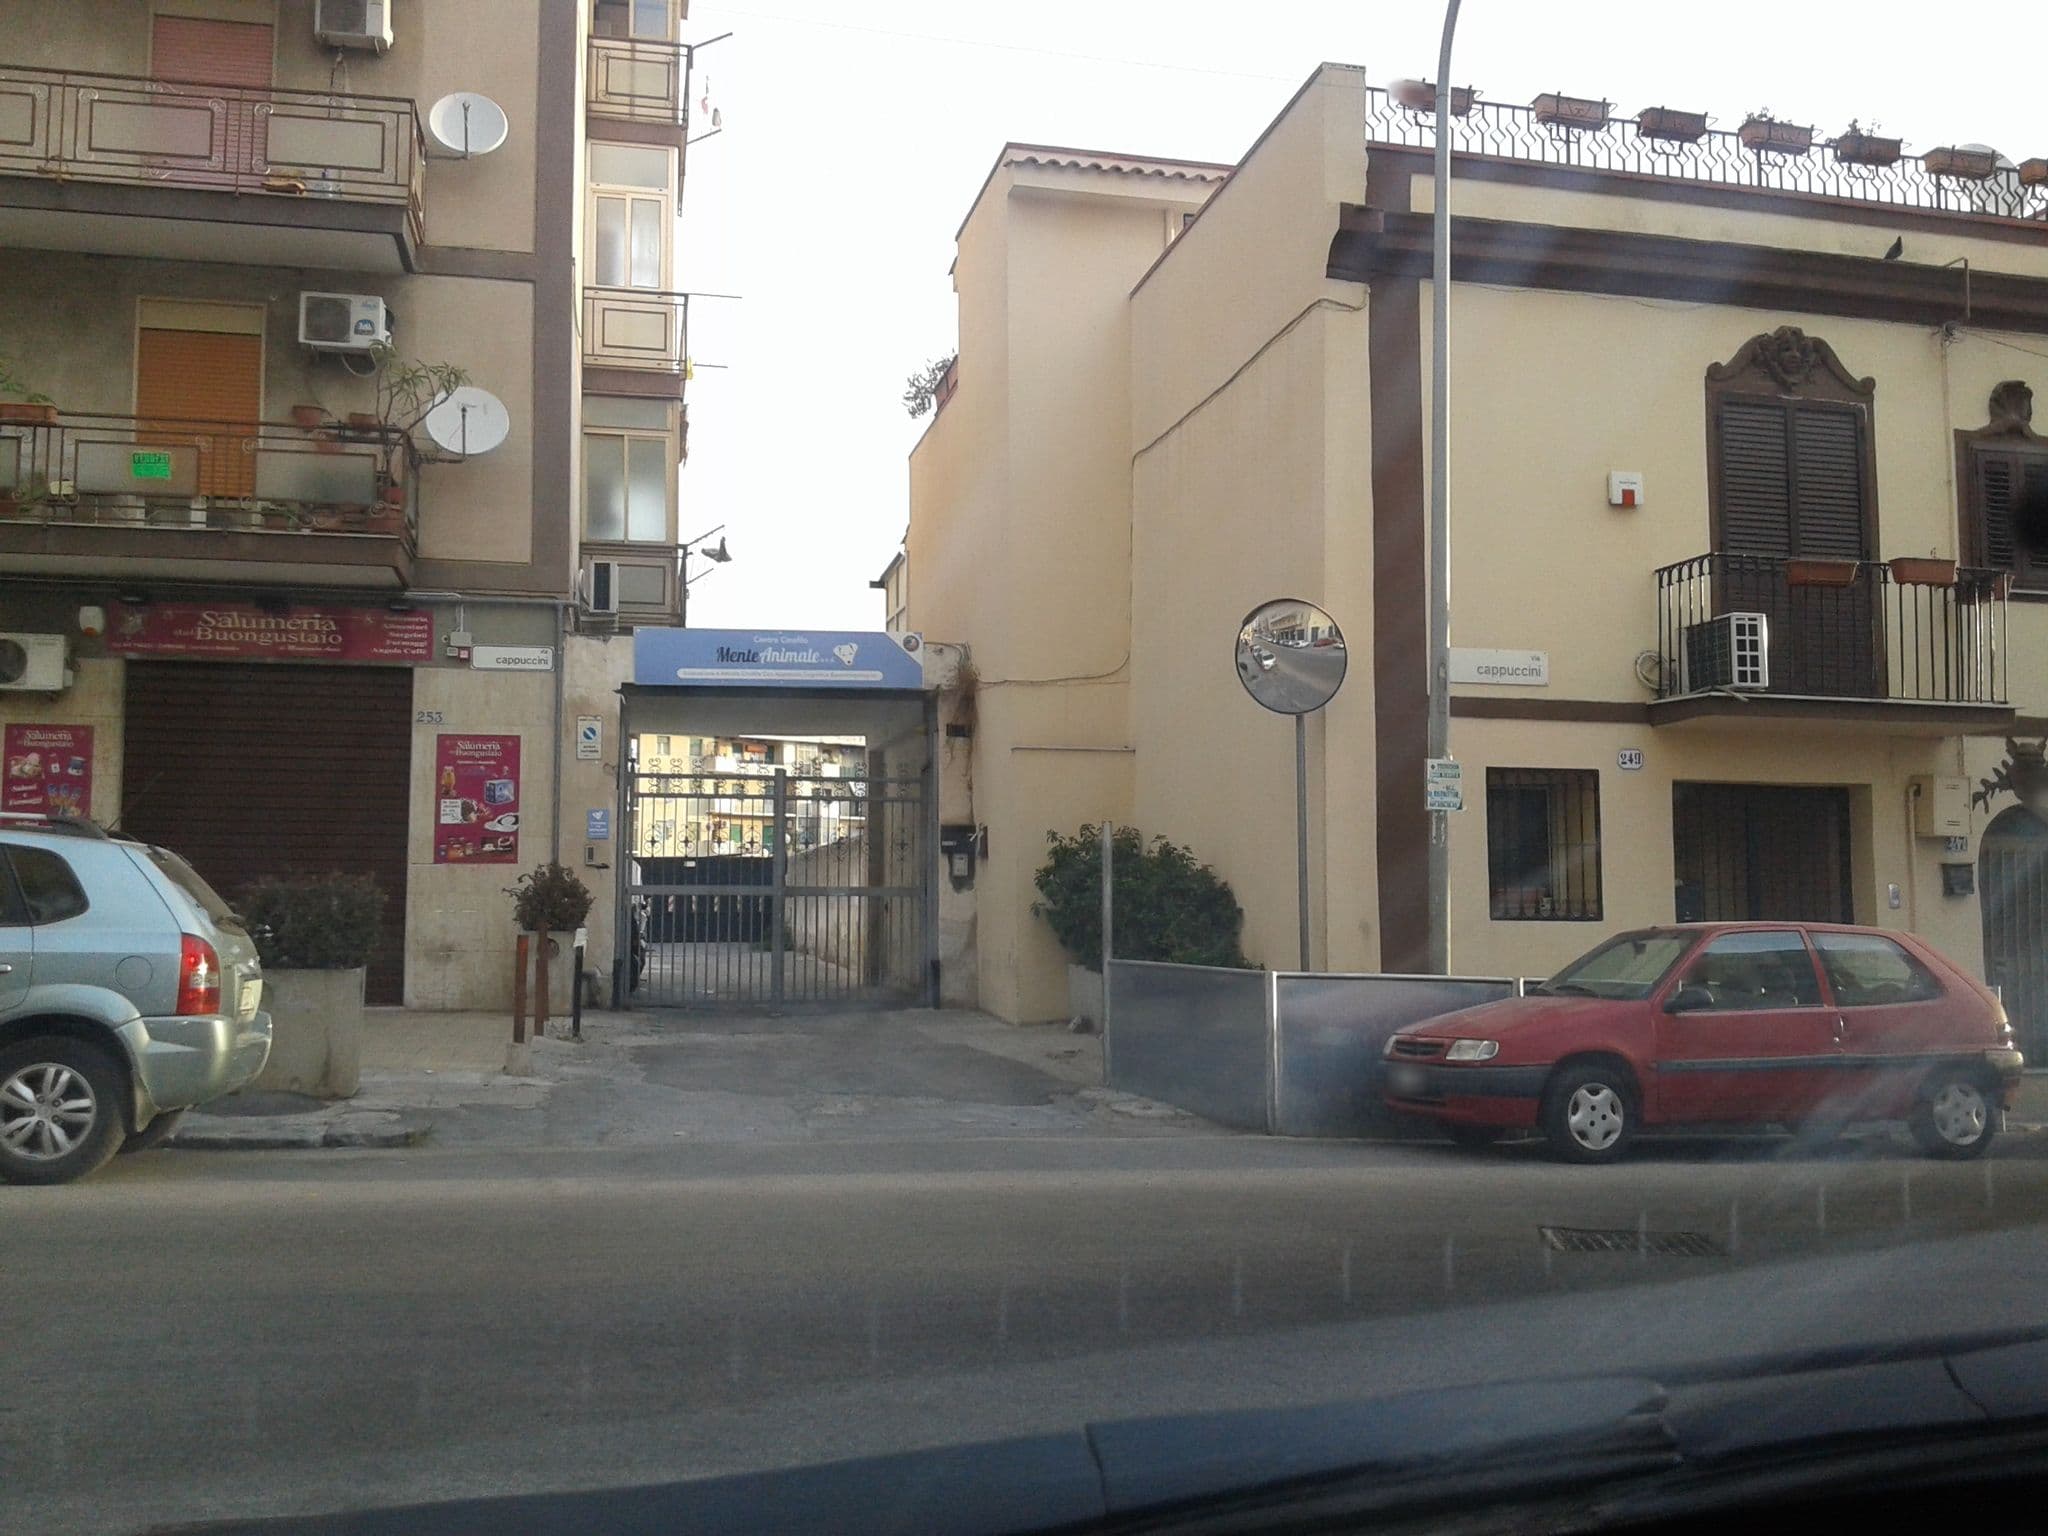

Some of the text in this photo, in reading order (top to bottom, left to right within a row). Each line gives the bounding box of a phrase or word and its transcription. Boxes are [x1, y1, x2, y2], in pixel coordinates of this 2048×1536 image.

[198, 610, 337, 631] Salumeria
[196, 626, 343, 646] Buongustaio
[386, 639, 428, 648] Formaggi
[371, 647, 402, 656] Angolo
[716, 646, 760, 663] Mente
[496, 656, 549, 666] cappuccini
[1476, 664, 1541, 678] cappuccini
[416, 711, 443, 723] 253
[26, 730, 72, 740] Salumeria
[457, 741, 501, 750] Salumeria
[1620, 752, 1641, 765] 249
